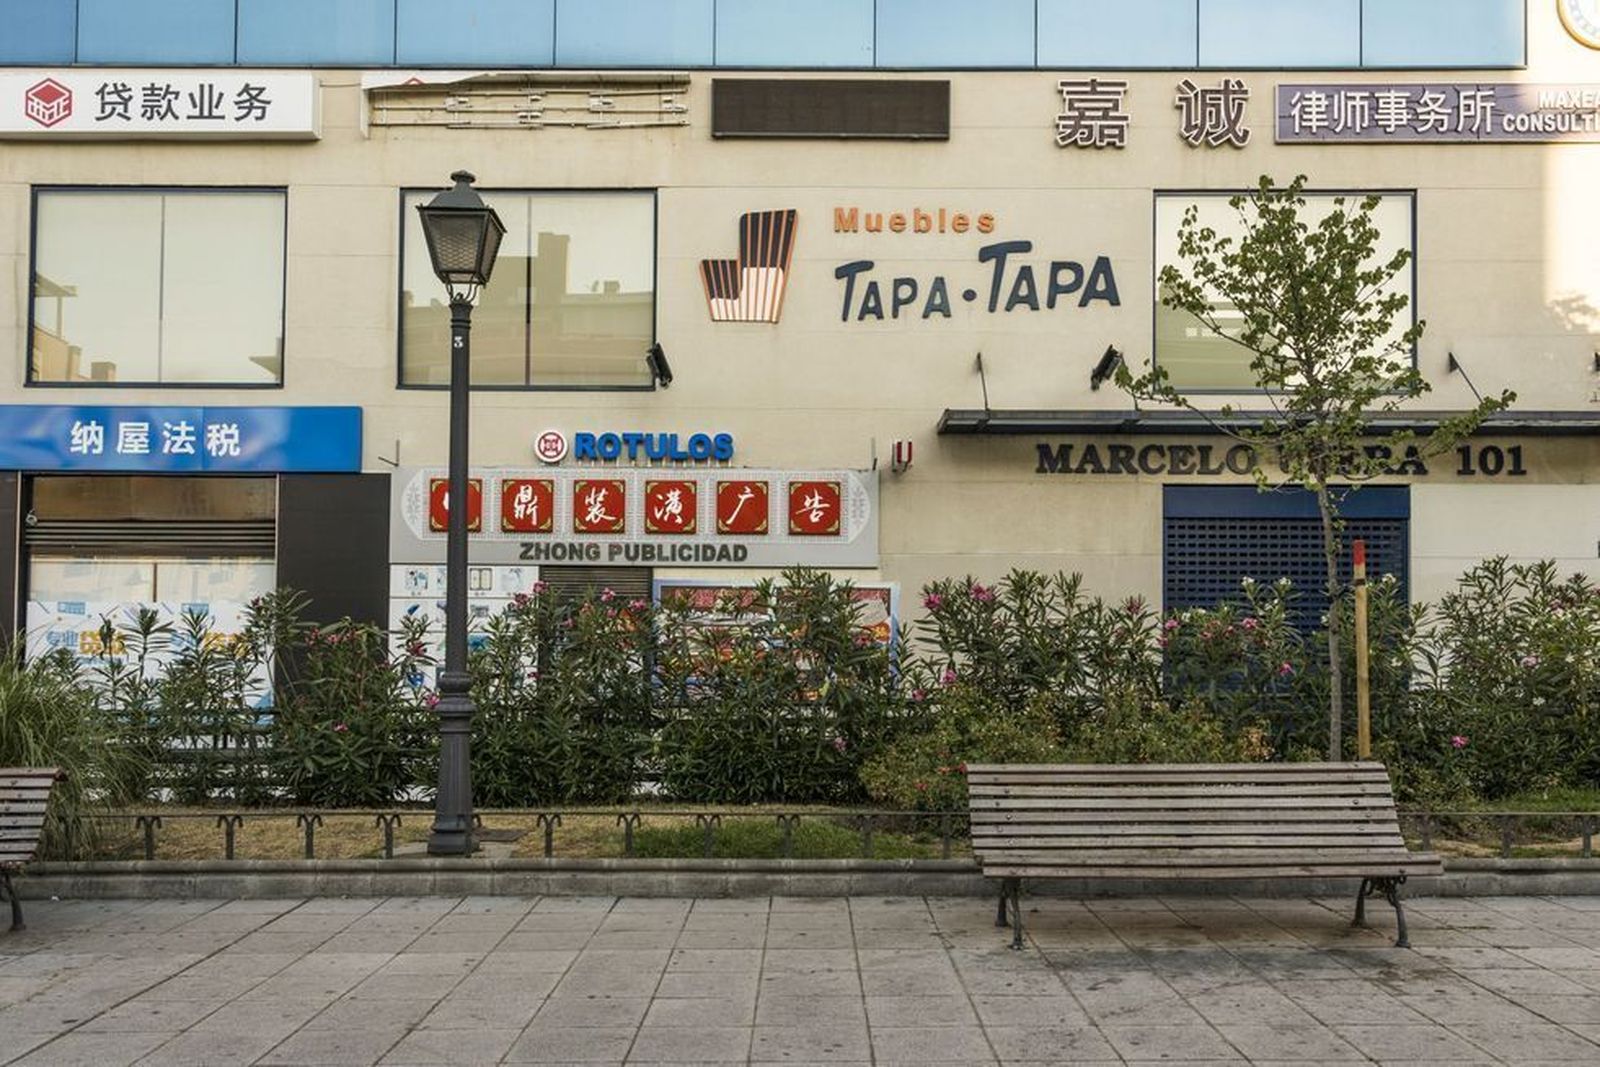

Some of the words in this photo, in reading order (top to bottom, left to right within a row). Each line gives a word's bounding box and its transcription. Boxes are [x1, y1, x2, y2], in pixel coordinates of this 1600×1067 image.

[94, 82, 272, 121] 贷款业务
[1290, 90, 1496, 134] 律师事务所
[834, 207, 996, 234] Muebles
[70, 420, 242, 457] 纳屋法税
[574, 432, 734, 461] ROTULOS
[1035, 443, 1257, 475] MARCELO
[1456, 444, 1528, 476] 101
[443, 484, 830, 526] 鼎装潢广告
[519, 543, 601, 562] ZHONG
[608, 543, 748, 563] PUBLICIDAD
